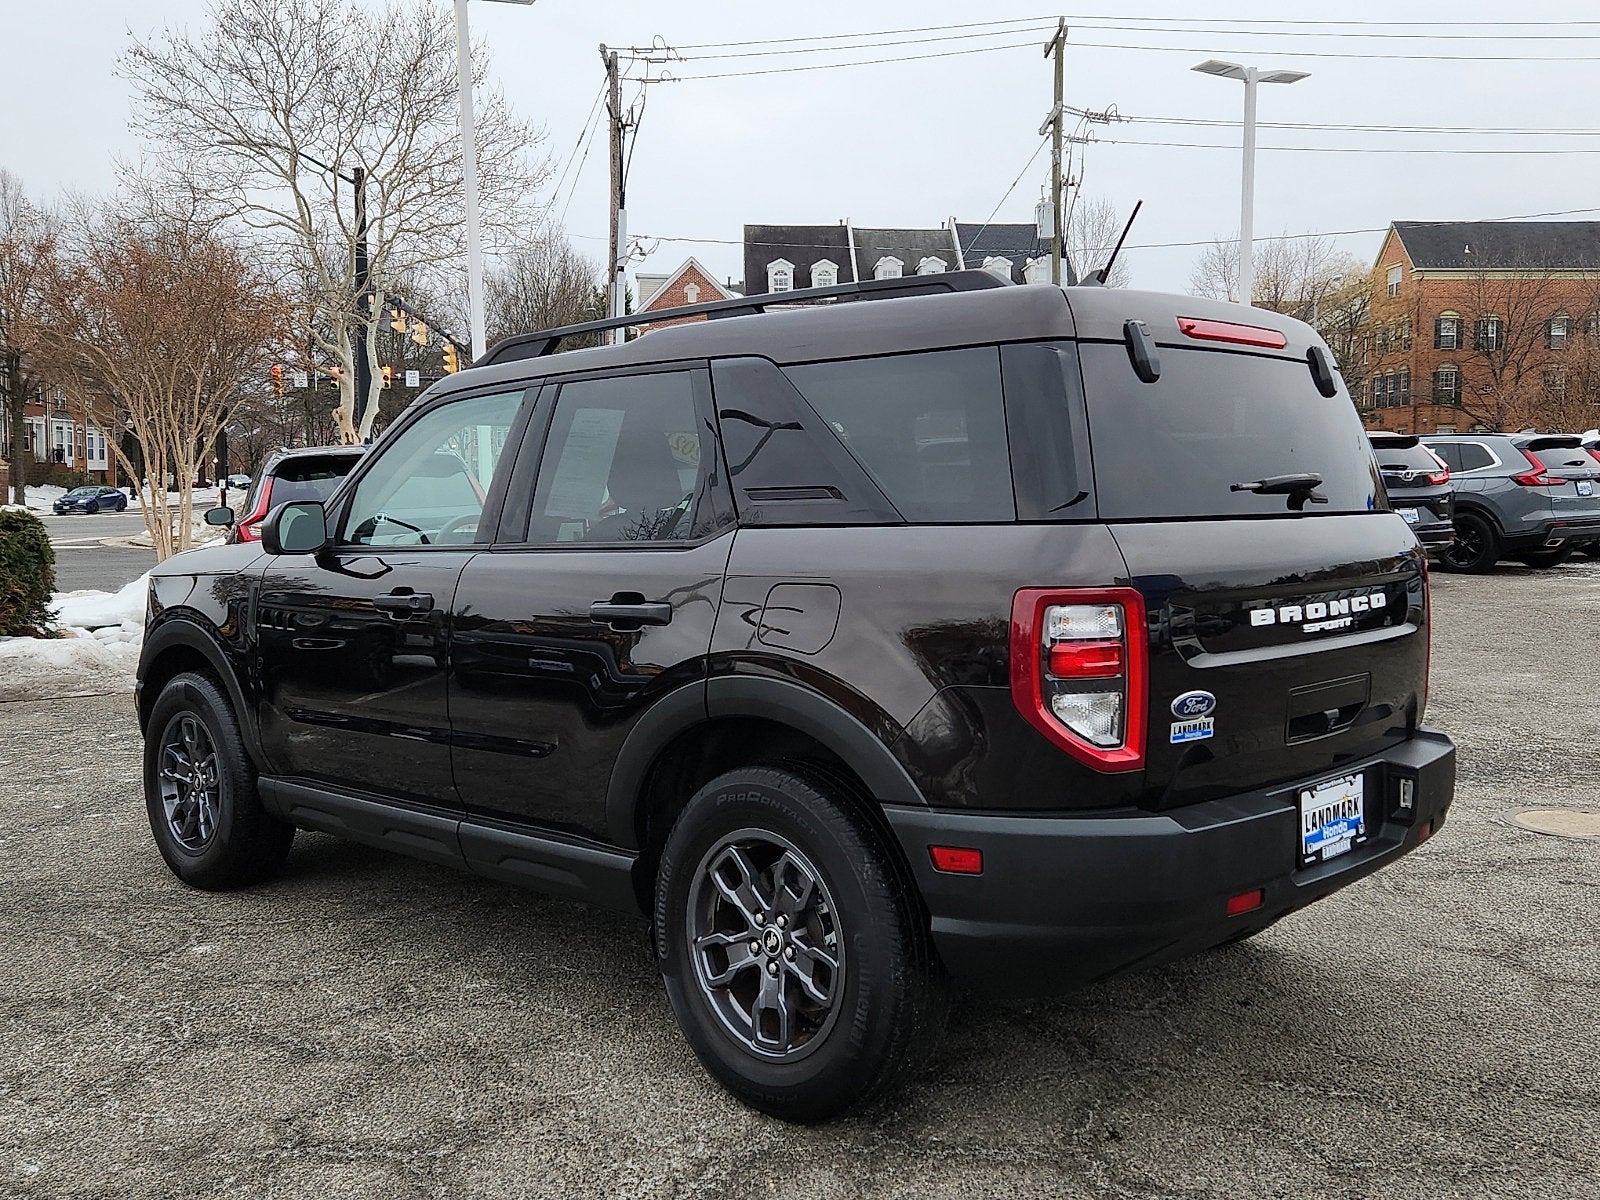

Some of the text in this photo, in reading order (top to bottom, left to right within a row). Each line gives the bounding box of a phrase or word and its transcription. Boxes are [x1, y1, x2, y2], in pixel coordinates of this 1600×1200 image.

[1250, 592, 1387, 627] BRONCO
[1303, 616, 1354, 633] SPORT
[1183, 697, 1209, 713] Ford
[1173, 721, 1211, 735] LANDMARK
[1304, 796, 1360, 834] LANDMARK
[1323, 820, 1348, 840] Honda
